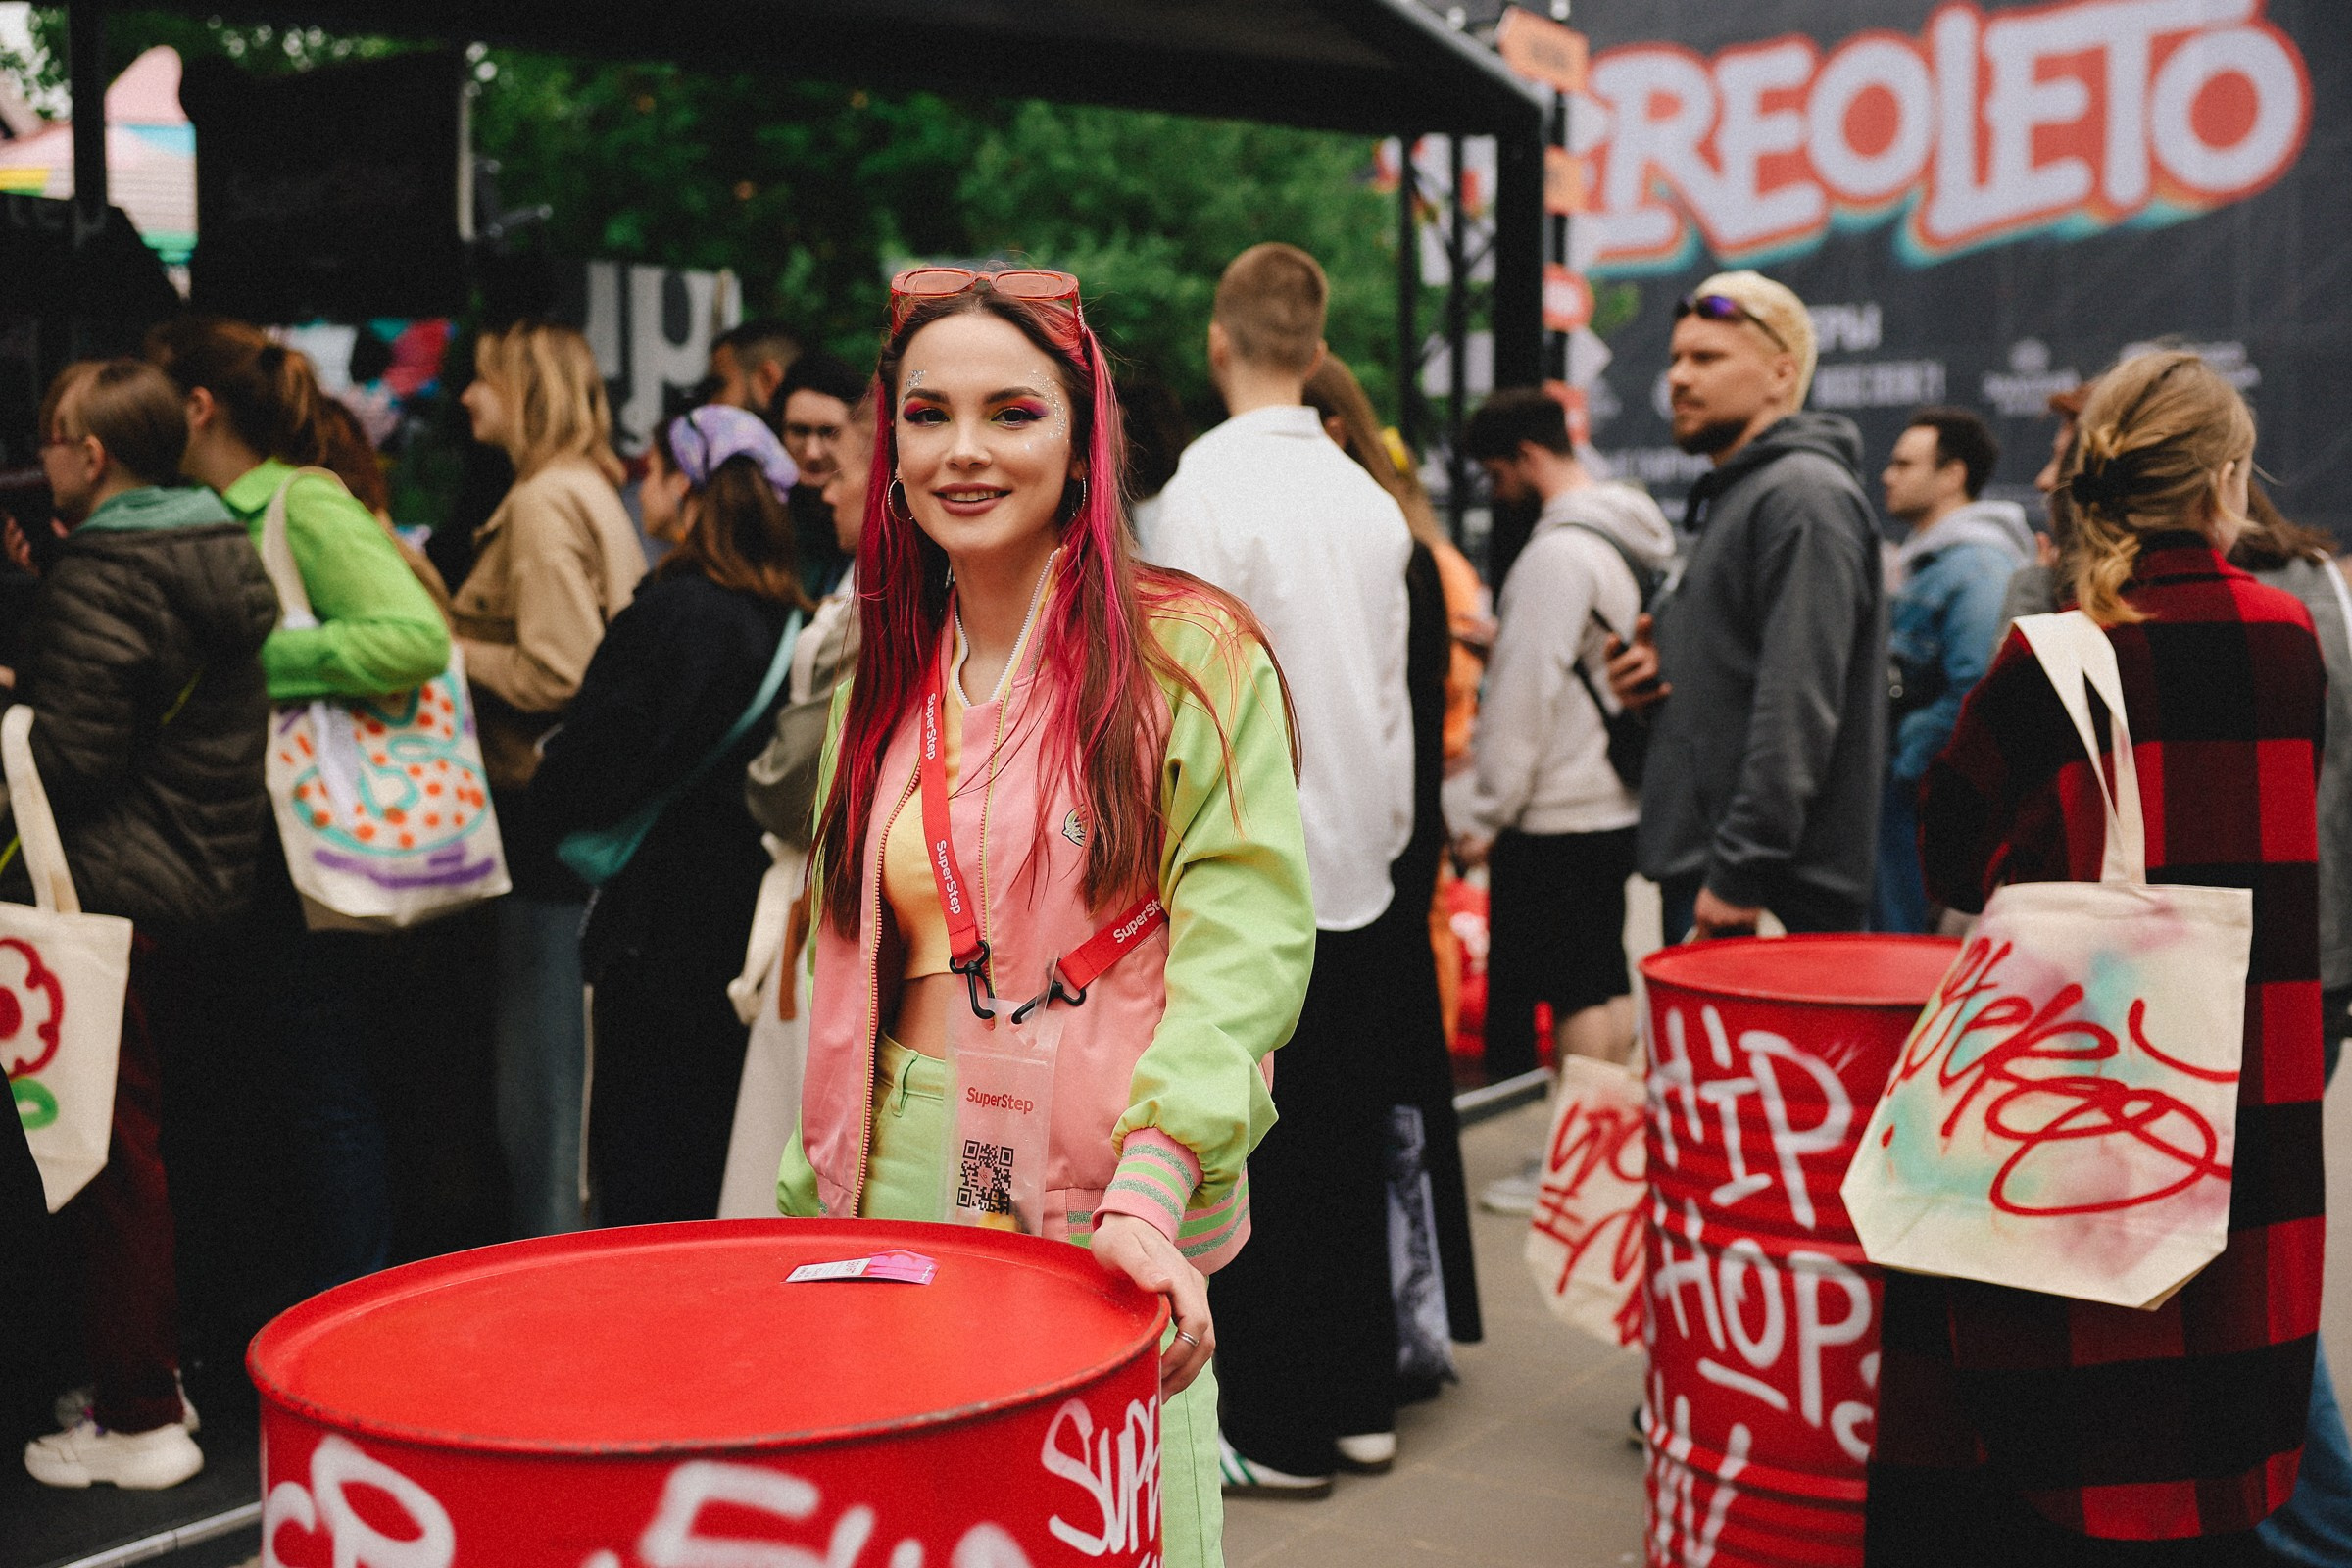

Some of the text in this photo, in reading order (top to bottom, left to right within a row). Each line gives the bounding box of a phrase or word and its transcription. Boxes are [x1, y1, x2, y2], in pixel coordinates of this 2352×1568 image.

[1574, 0, 2307, 261] REOLETO
[926, 691, 937, 760] SuperStep
[936, 840, 961, 915] SuperStep
[1112, 898, 1161, 944] SuperSt
[965, 1086, 1035, 1115] SuperStep
